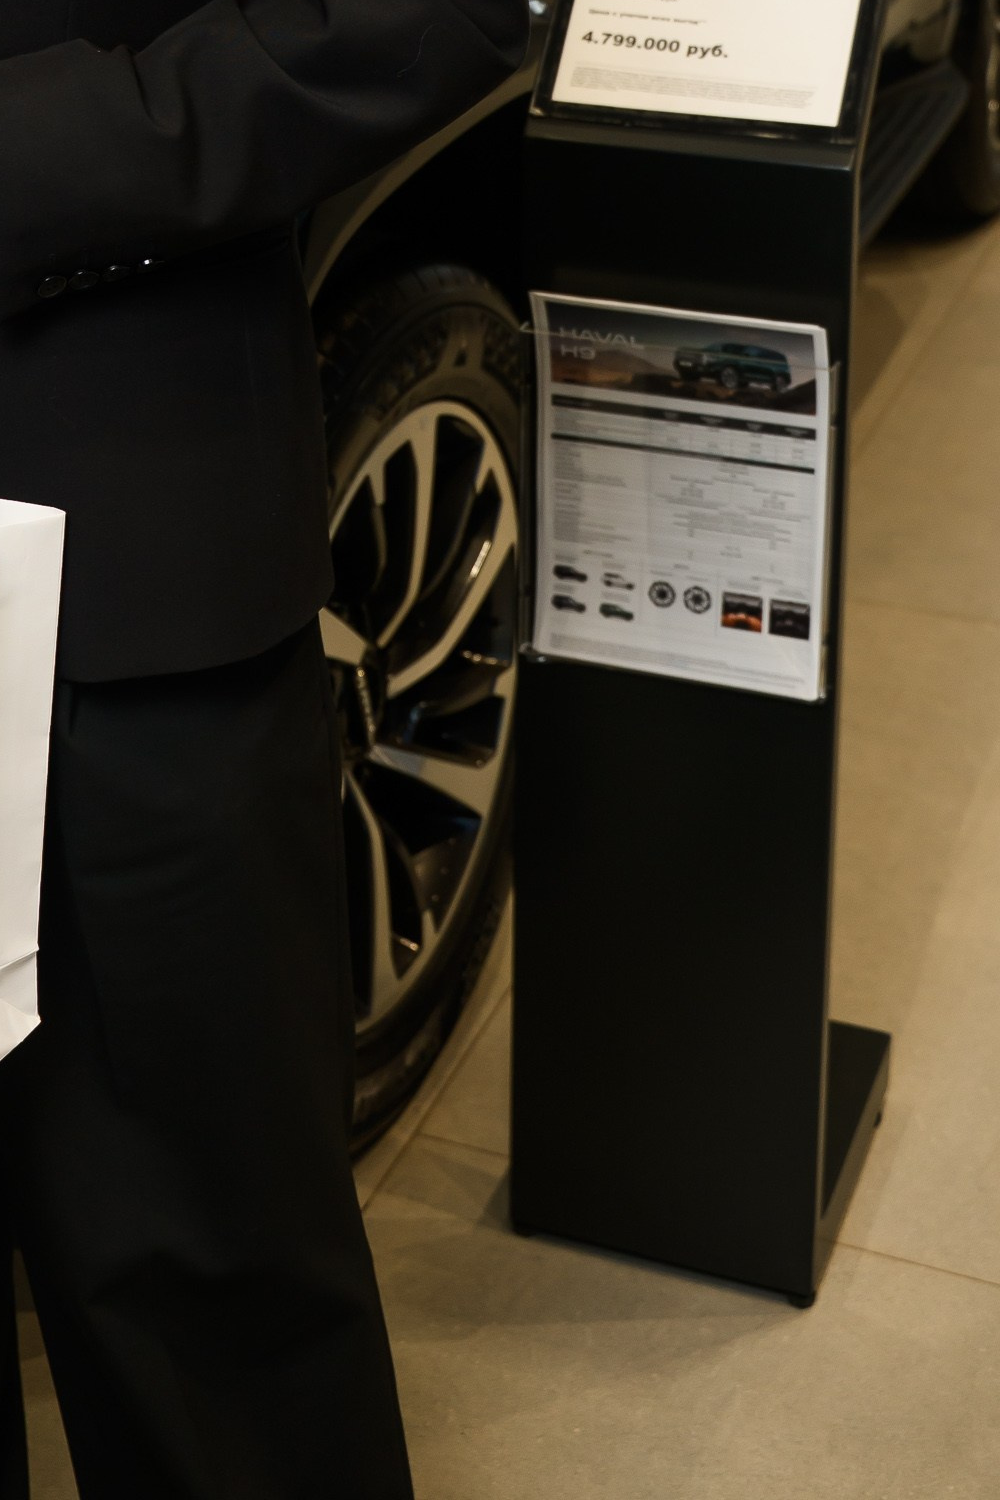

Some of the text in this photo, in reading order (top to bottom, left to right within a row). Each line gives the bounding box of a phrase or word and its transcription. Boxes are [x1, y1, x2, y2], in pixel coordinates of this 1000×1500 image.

[581, 30, 729, 60] 4.799.000 руб.
[559, 327, 644, 350] HAVAL
[560, 344, 596, 360] H9
